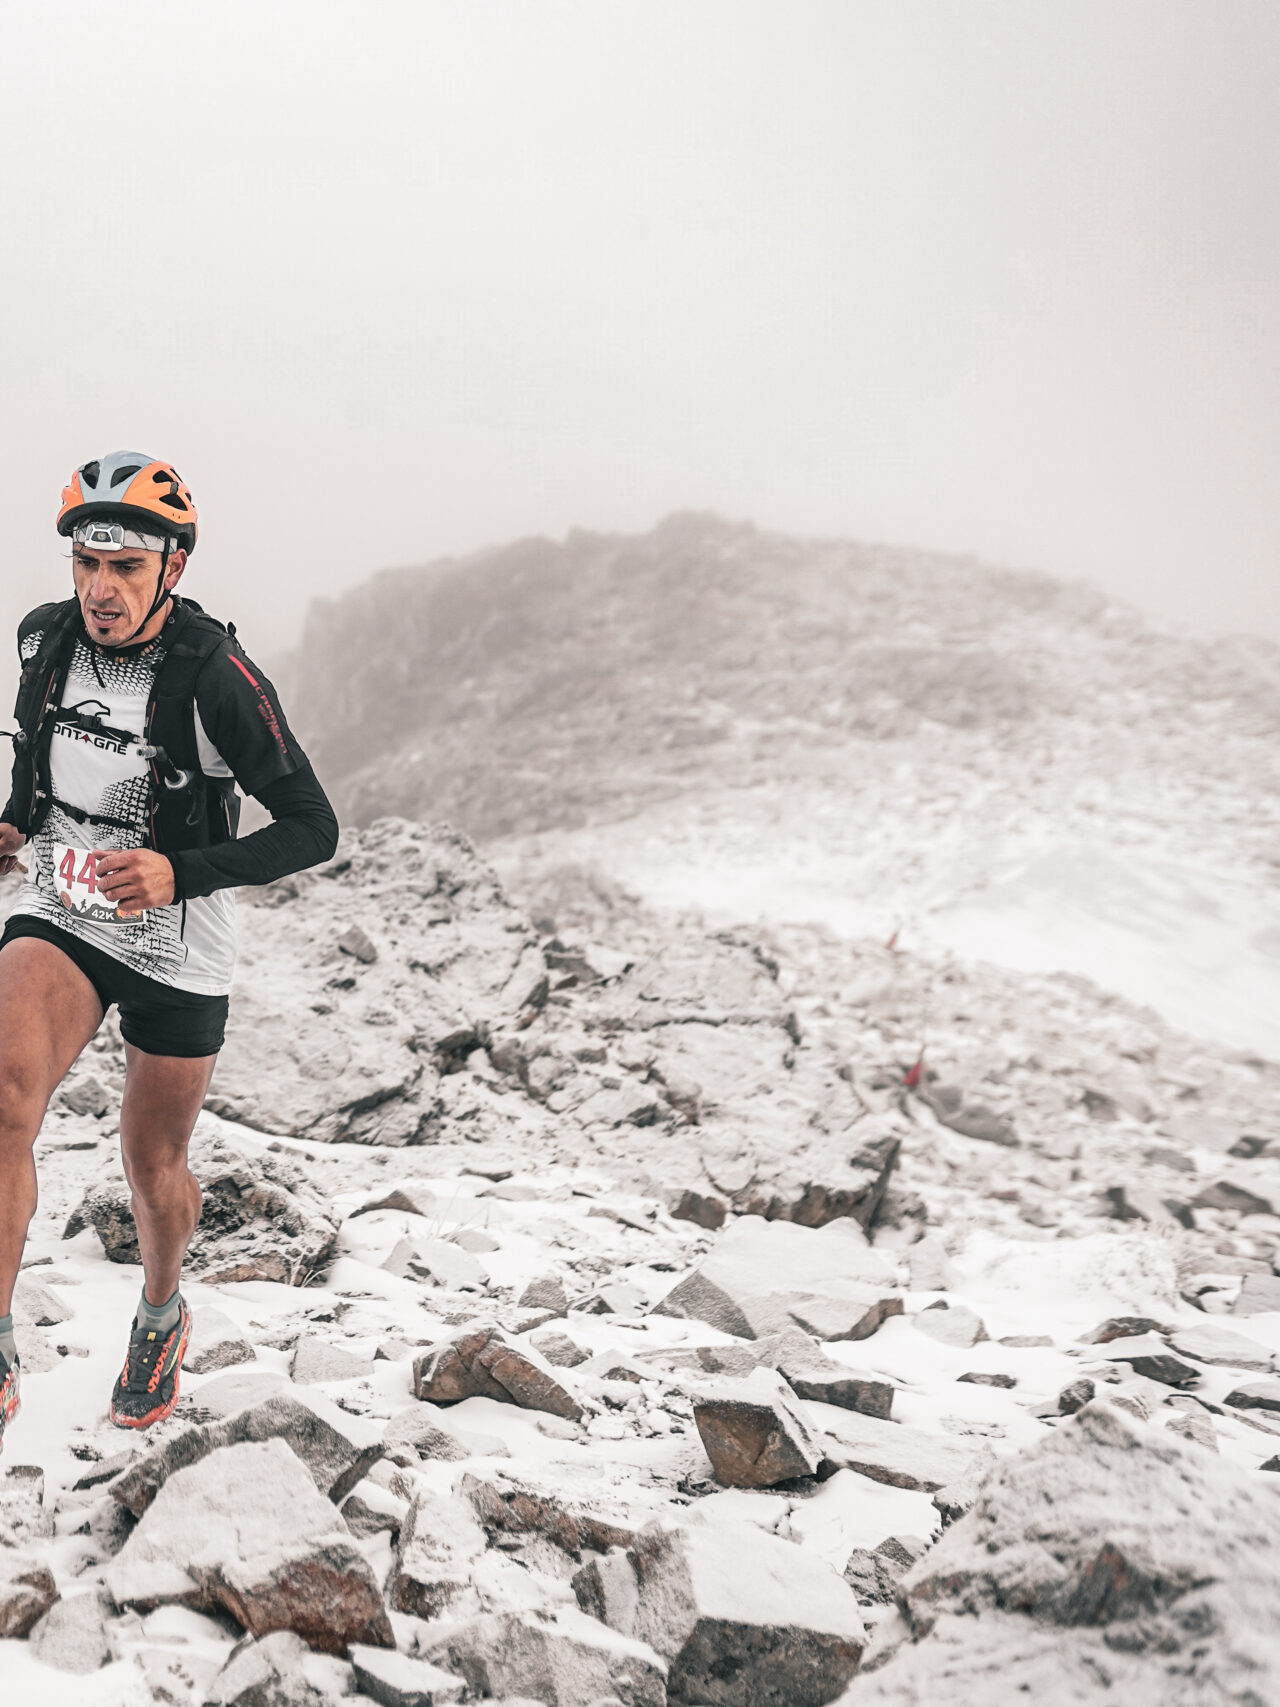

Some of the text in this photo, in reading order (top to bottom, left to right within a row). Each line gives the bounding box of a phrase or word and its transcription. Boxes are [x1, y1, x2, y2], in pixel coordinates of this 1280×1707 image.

[53, 723, 128, 756] ONTAGNE
[59, 848, 98, 894] 44
[91, 909, 115, 920] 42K
